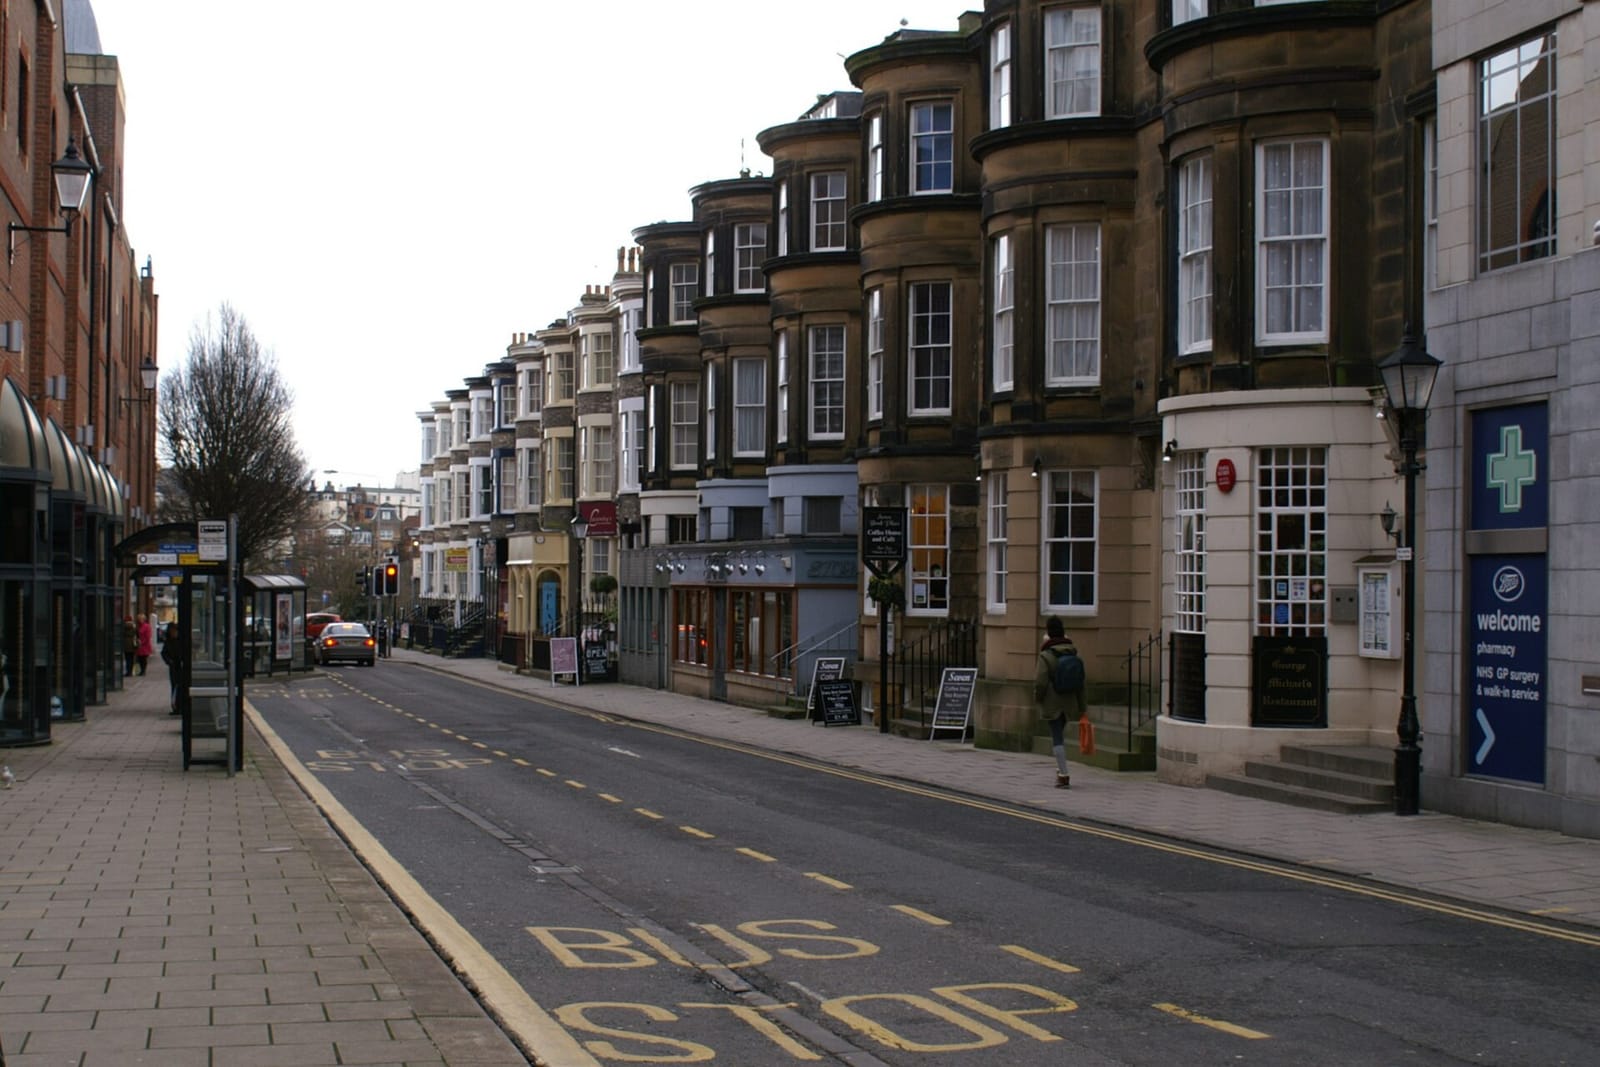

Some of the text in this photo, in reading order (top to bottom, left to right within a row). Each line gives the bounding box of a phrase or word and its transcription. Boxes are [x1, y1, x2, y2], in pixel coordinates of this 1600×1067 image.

[1477, 609, 1541, 633] welcome
[586, 648, 608, 658] OPEN
[1476, 641, 1516, 658] pharmacy
[1271, 658, 1307, 672] George
[1476, 665, 1540, 685] NHS GP surgery
[1263, 695, 1318, 706] Restaurant
[1476, 684, 1540, 701] & walk-in service
[316, 750, 451, 759] BUS
[304, 758, 493, 772] STOP
[524, 919, 881, 969] BUS
[555, 982, 1078, 1063] STOP
